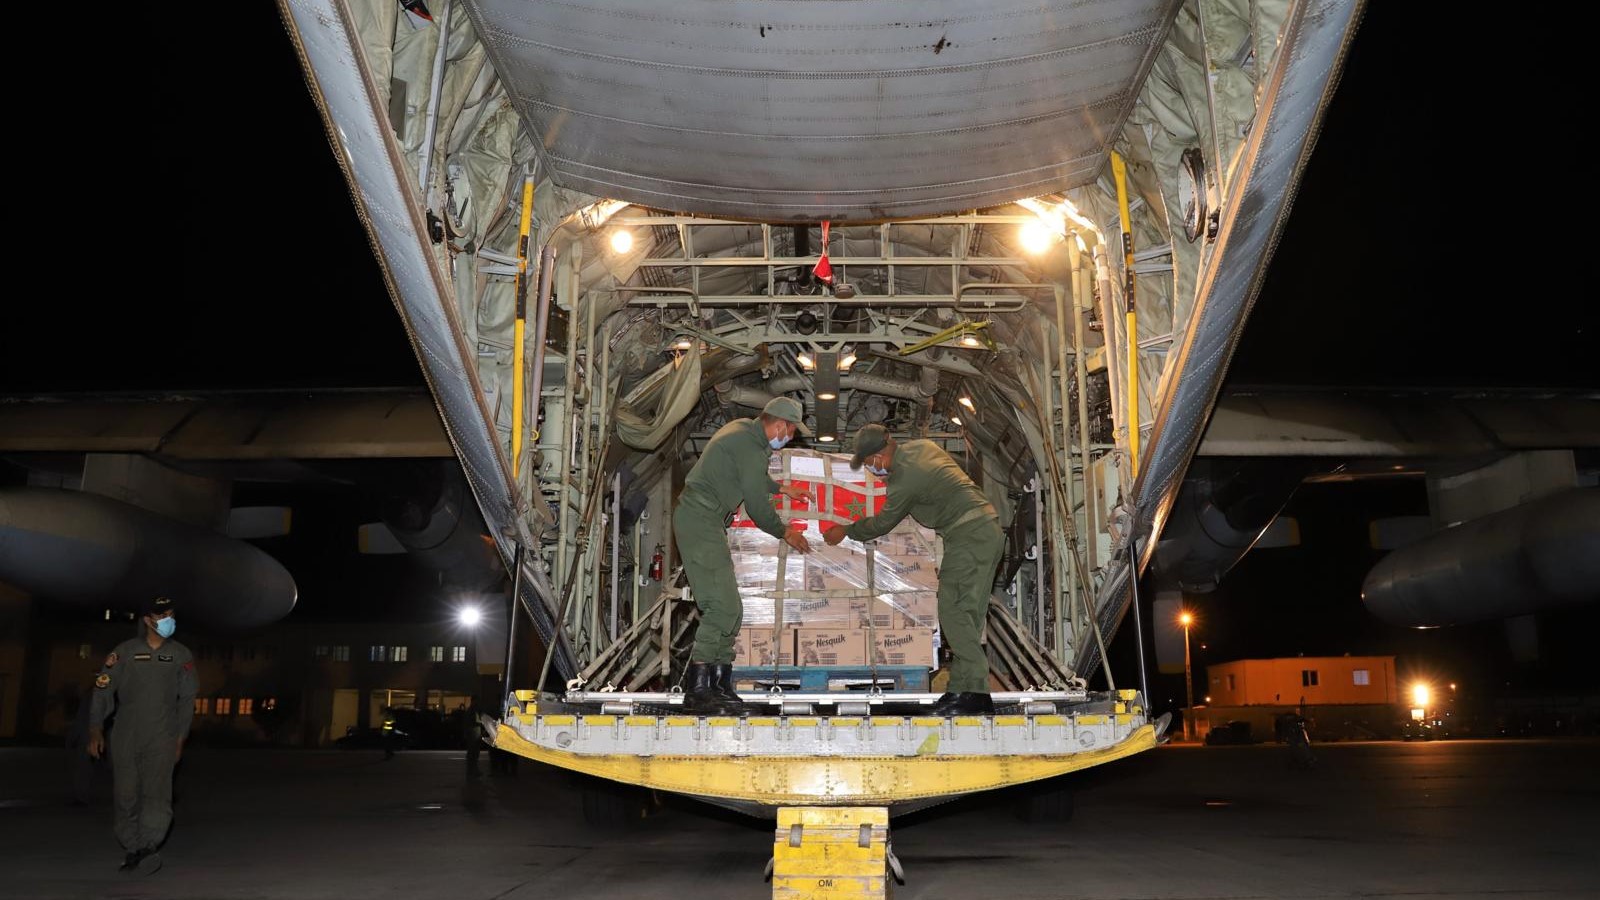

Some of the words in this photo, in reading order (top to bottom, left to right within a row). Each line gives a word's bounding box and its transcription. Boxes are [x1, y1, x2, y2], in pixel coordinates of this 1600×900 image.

[816, 633, 846, 648] Nesquik
[884, 634, 914, 648] Nesquik
[818, 879, 833, 887] OM
